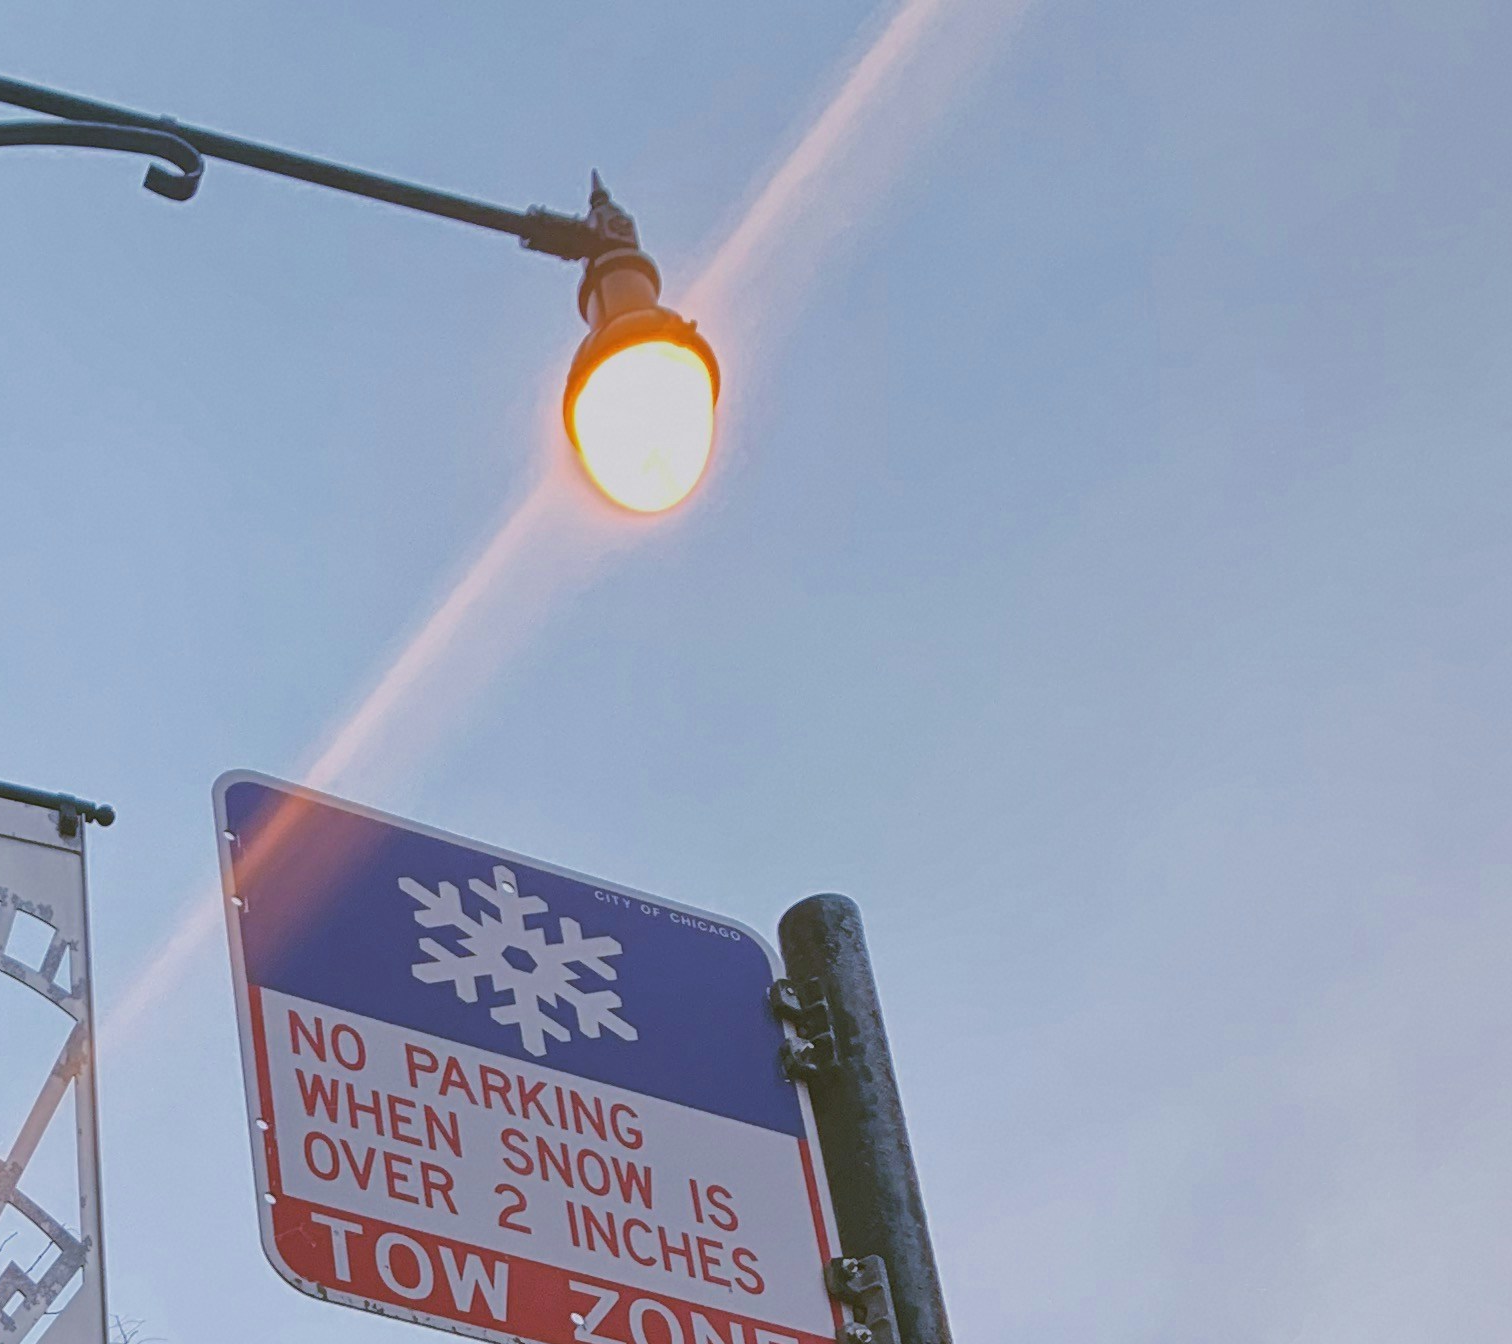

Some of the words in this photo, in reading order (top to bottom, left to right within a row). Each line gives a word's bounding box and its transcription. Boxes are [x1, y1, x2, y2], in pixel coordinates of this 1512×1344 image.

[594, 890, 631, 909] CITY
[640, 904, 661, 917] OF
[669, 912, 741, 942] CHICAGO
[288, 1010, 365, 1072] NO
[406, 1043, 644, 1150] PARKING
[295, 1069, 462, 1158] WHEN
[502, 1128, 653, 1210] SNOW
[690, 1178, 739, 1233] IS
[305, 1132, 458, 1215] OVER
[495, 1184, 532, 1235] 2
[567, 1204, 766, 1296] INCHES
[311, 1211, 511, 1323] TOW
